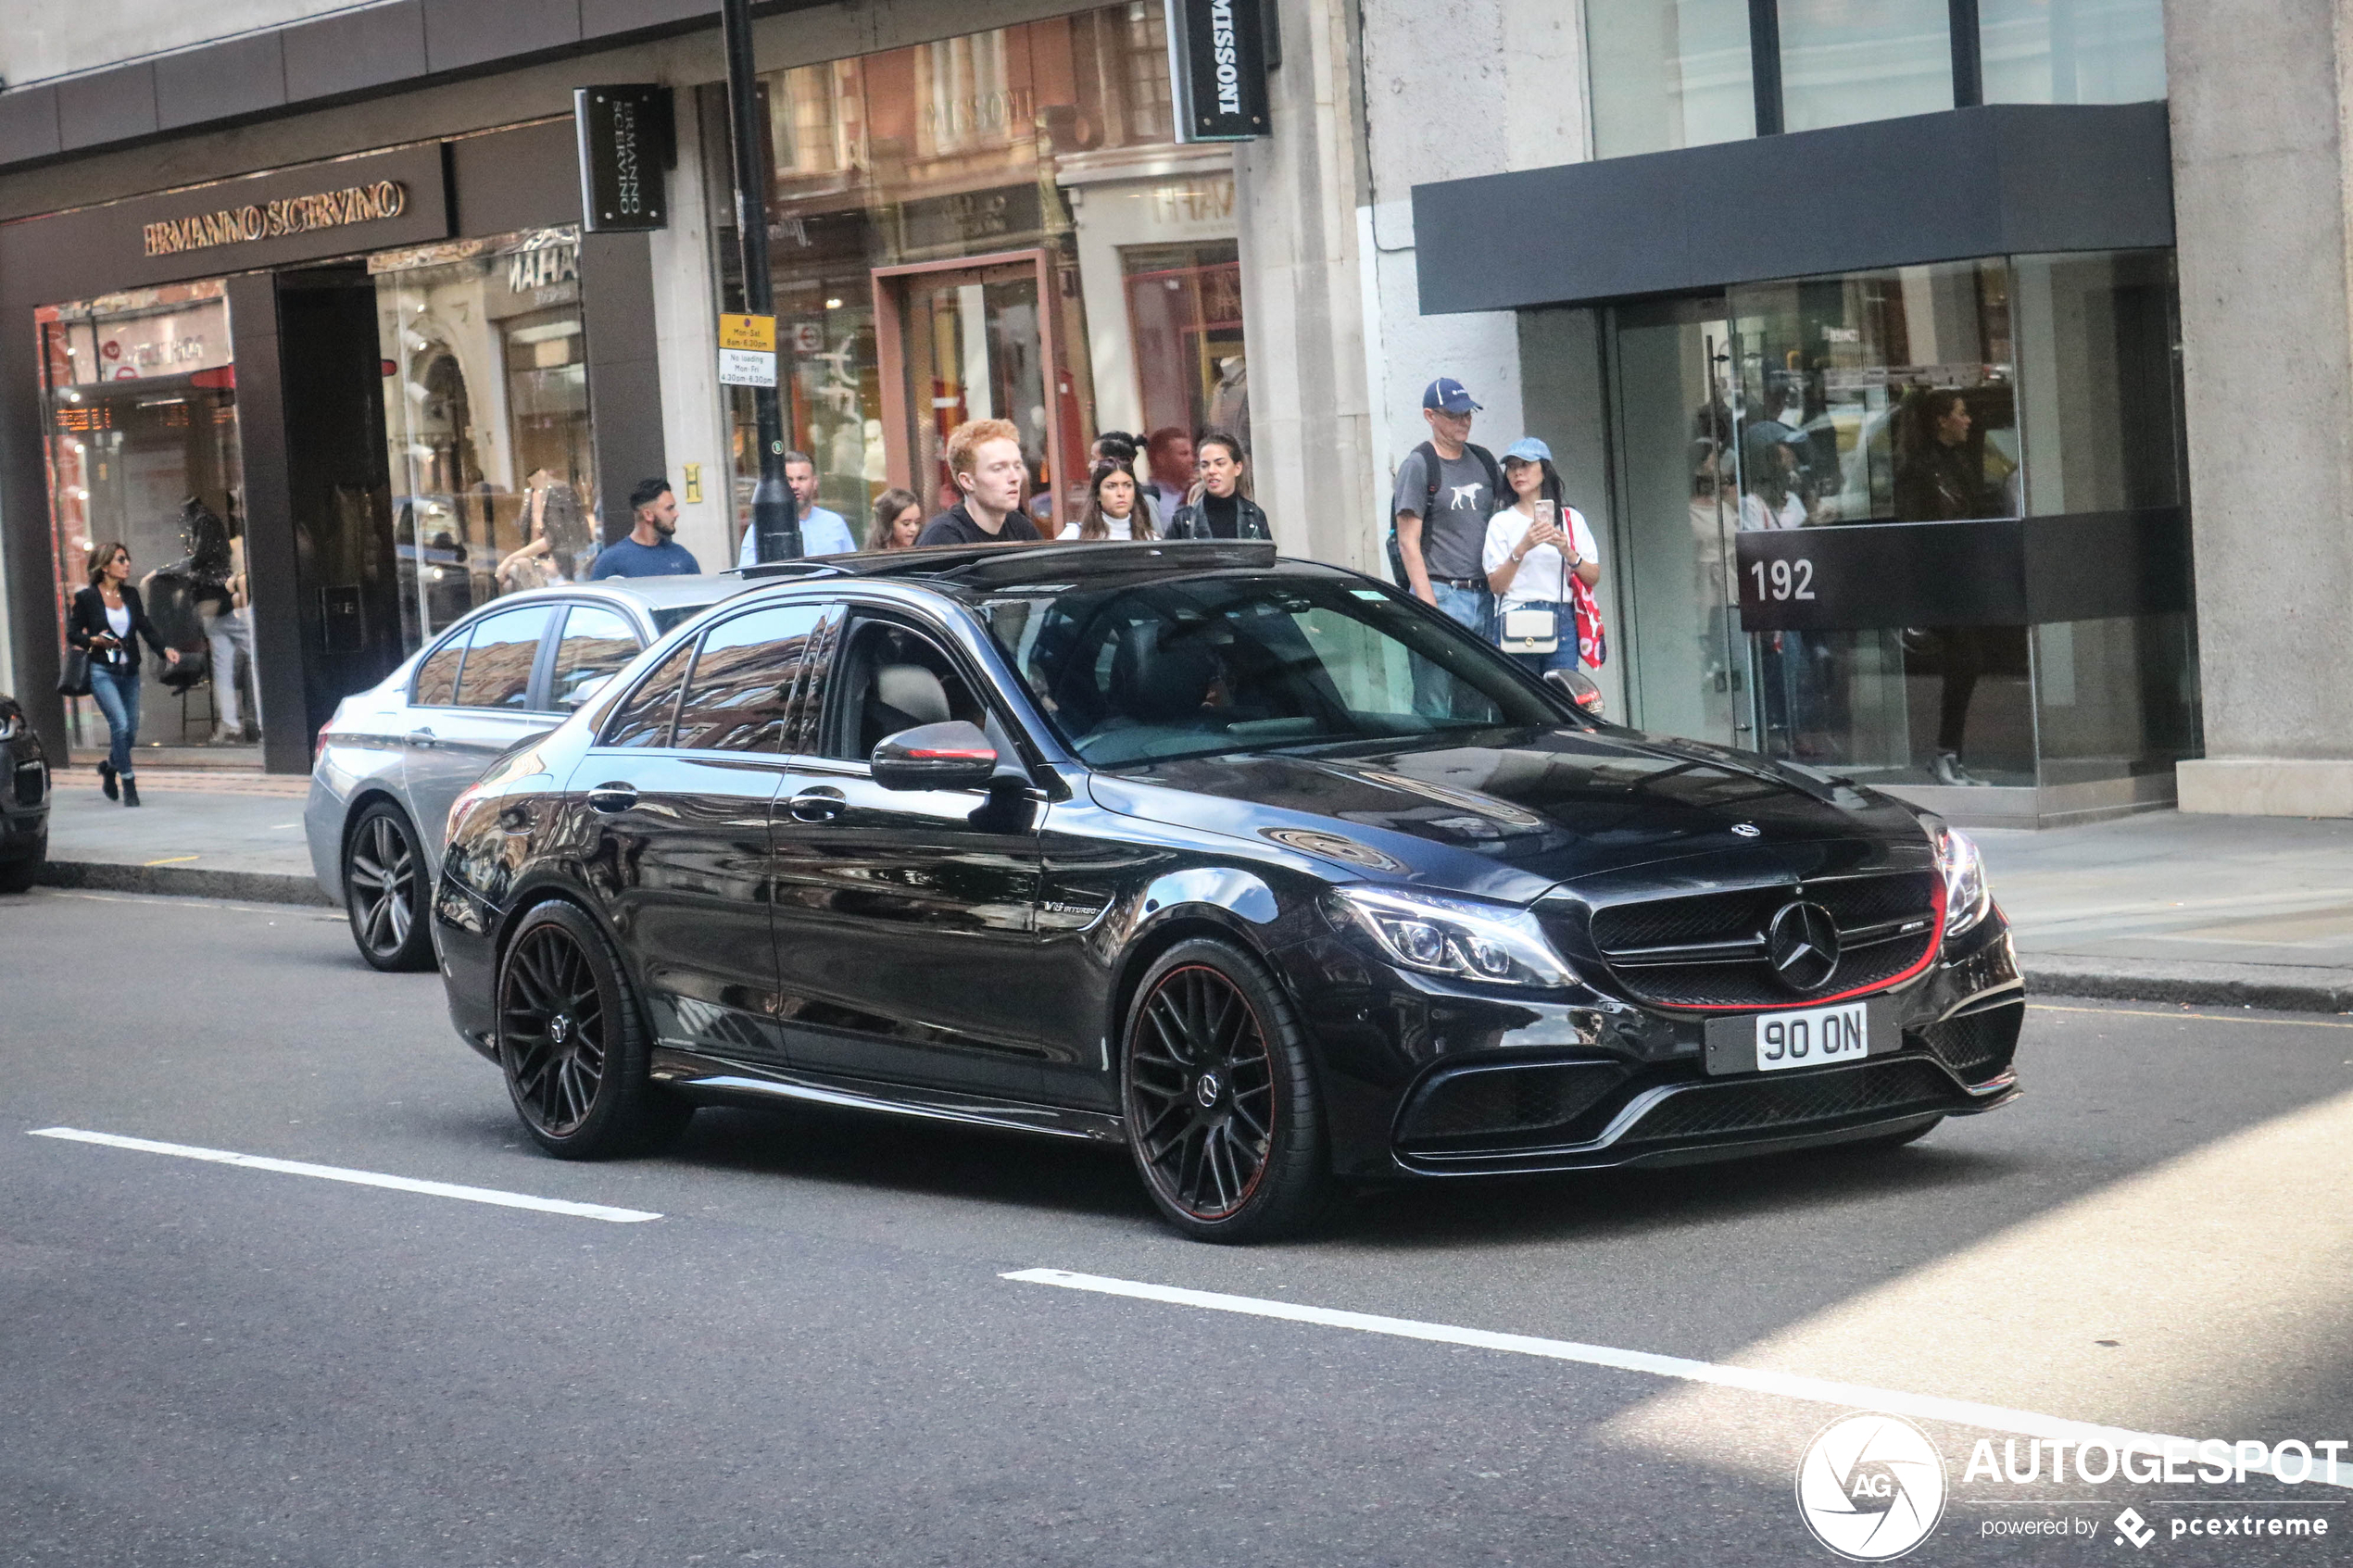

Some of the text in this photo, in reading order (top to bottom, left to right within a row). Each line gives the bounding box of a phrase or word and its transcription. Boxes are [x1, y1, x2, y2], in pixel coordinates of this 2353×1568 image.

[1212, 0, 1239, 115] MISSONI
[612, 101, 630, 214] SCERVINO
[624, 102, 641, 214] ERMANNO
[144, 180, 406, 257] ERMANNO SCERVINO
[742, 355, 763, 364] loading
[1751, 558, 1816, 601] 192
[1764, 1021, 1809, 1060] 90
